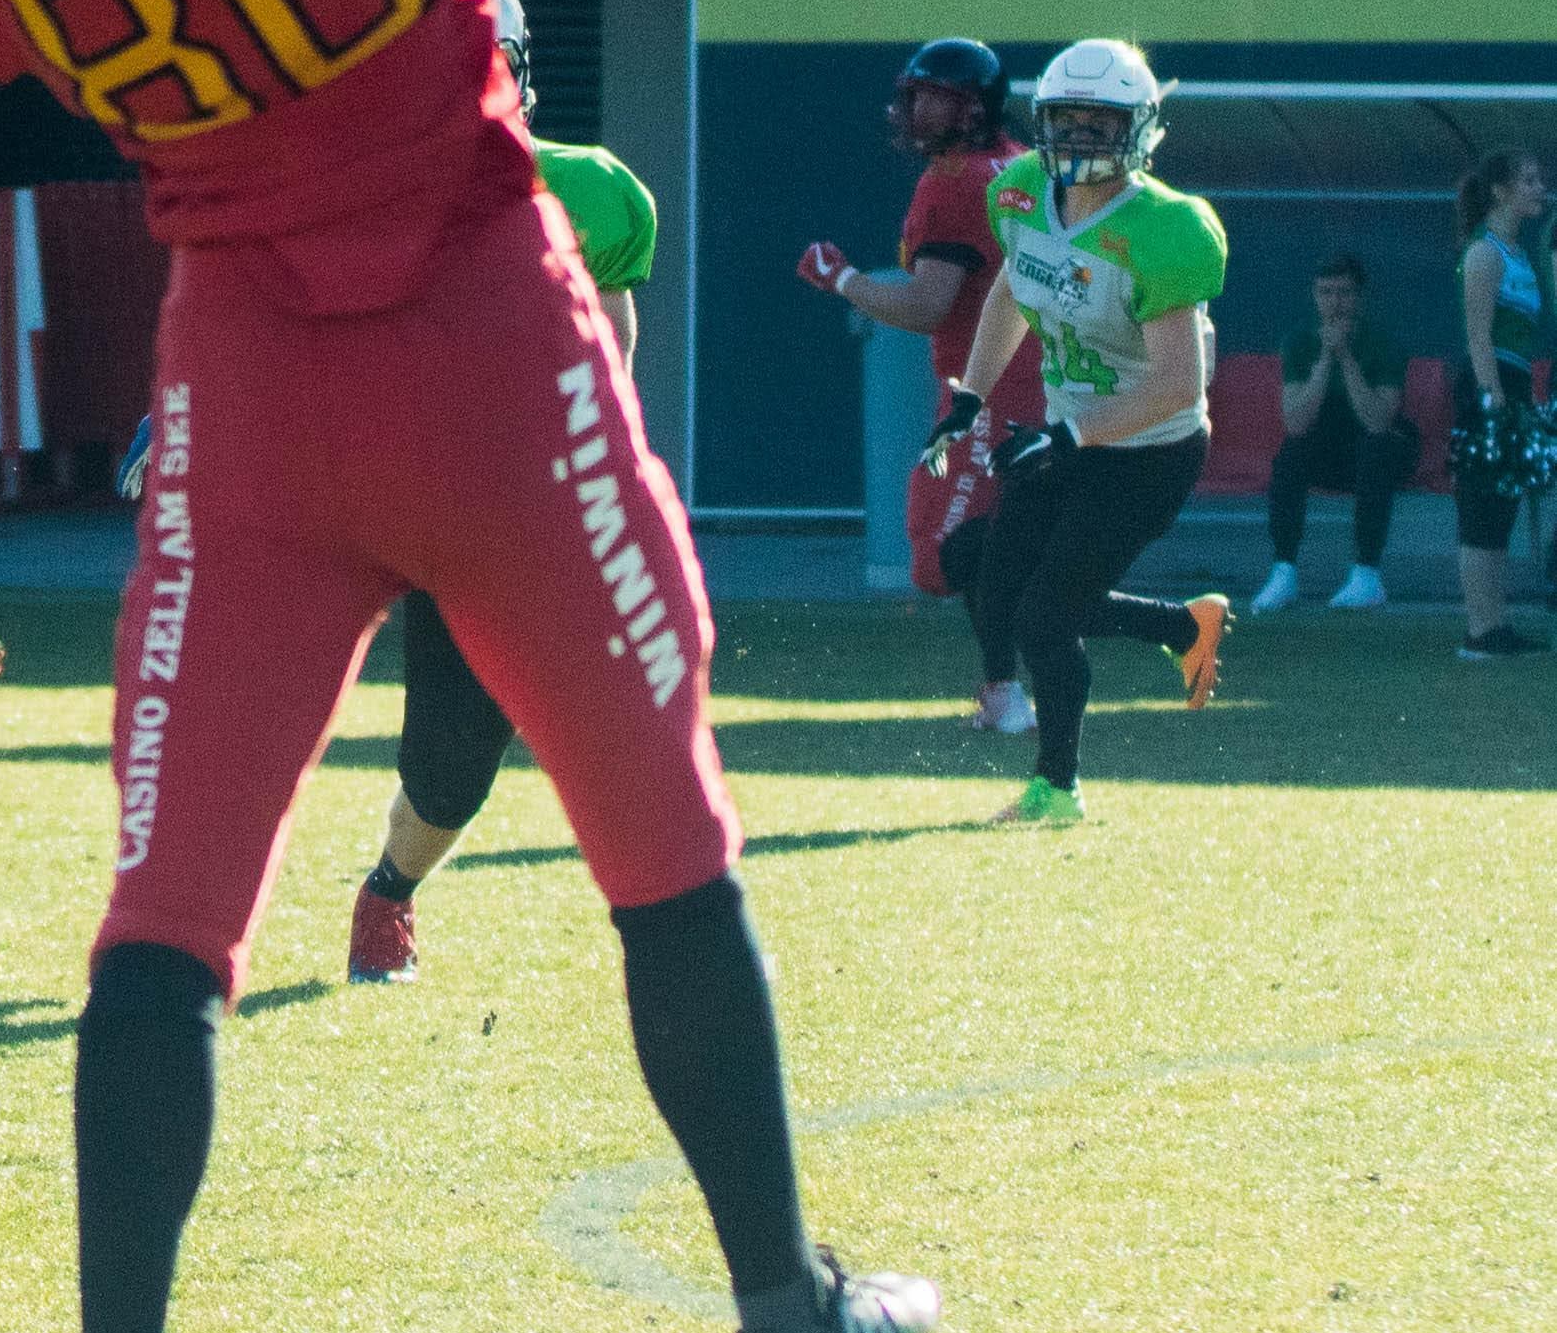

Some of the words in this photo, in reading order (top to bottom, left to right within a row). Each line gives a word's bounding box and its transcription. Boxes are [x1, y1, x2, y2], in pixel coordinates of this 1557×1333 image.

[161, 382, 192, 478] SEE
[155, 491, 196, 560] AM
[140, 567, 194, 683] ZELL
[117, 695, 170, 870] CASINO
